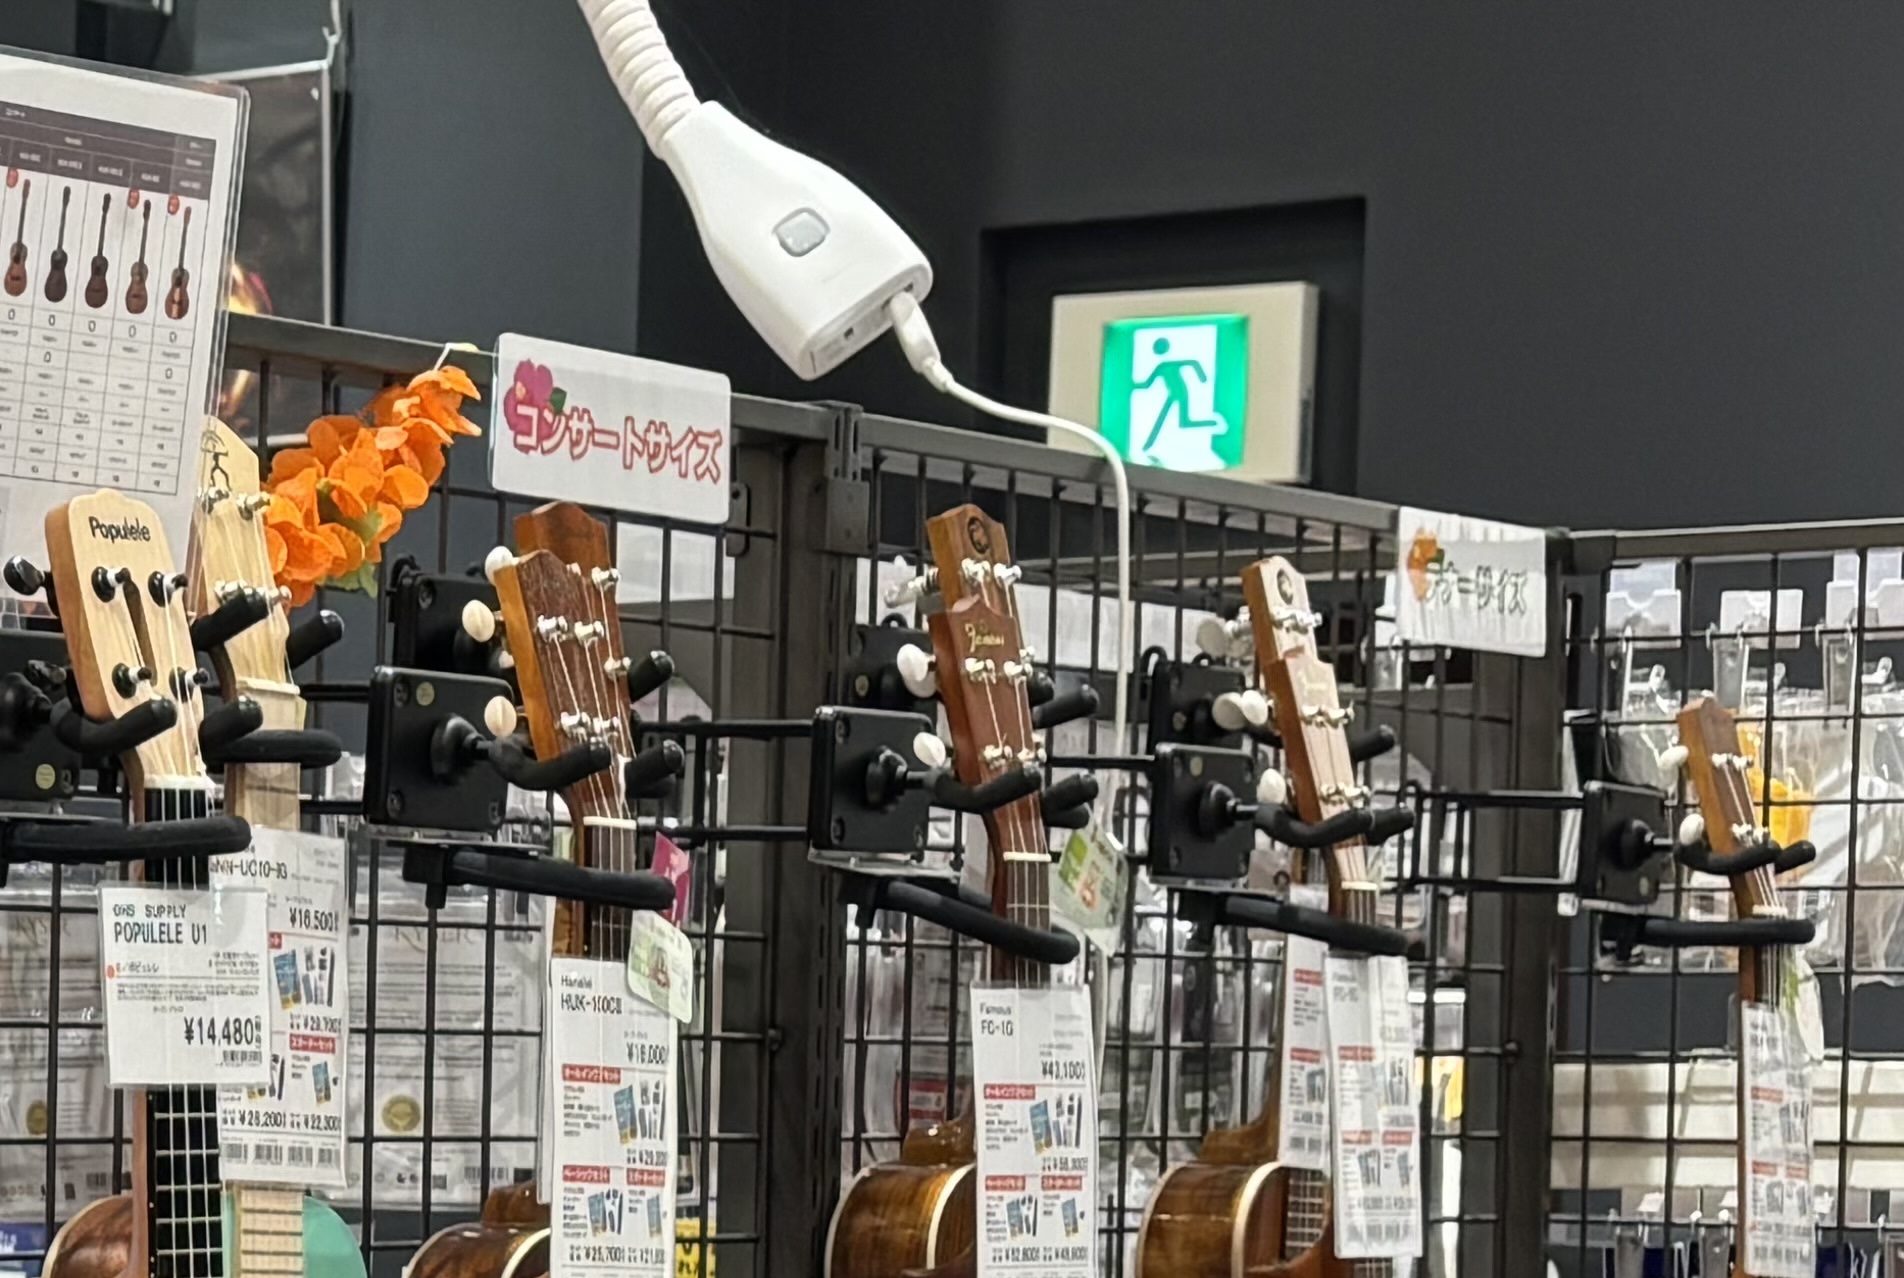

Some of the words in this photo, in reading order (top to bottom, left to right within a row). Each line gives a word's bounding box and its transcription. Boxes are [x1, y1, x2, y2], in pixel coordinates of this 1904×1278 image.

[514, 404, 723, 485] コンサートサイズ
[88, 516, 152, 544] Populele
[144, 904, 188, 919] SUPPLY
[113, 922, 184, 945] POPULELE
[191, 922, 208, 945] U1
[183, 1016, 255, 1047] ¥14,480
